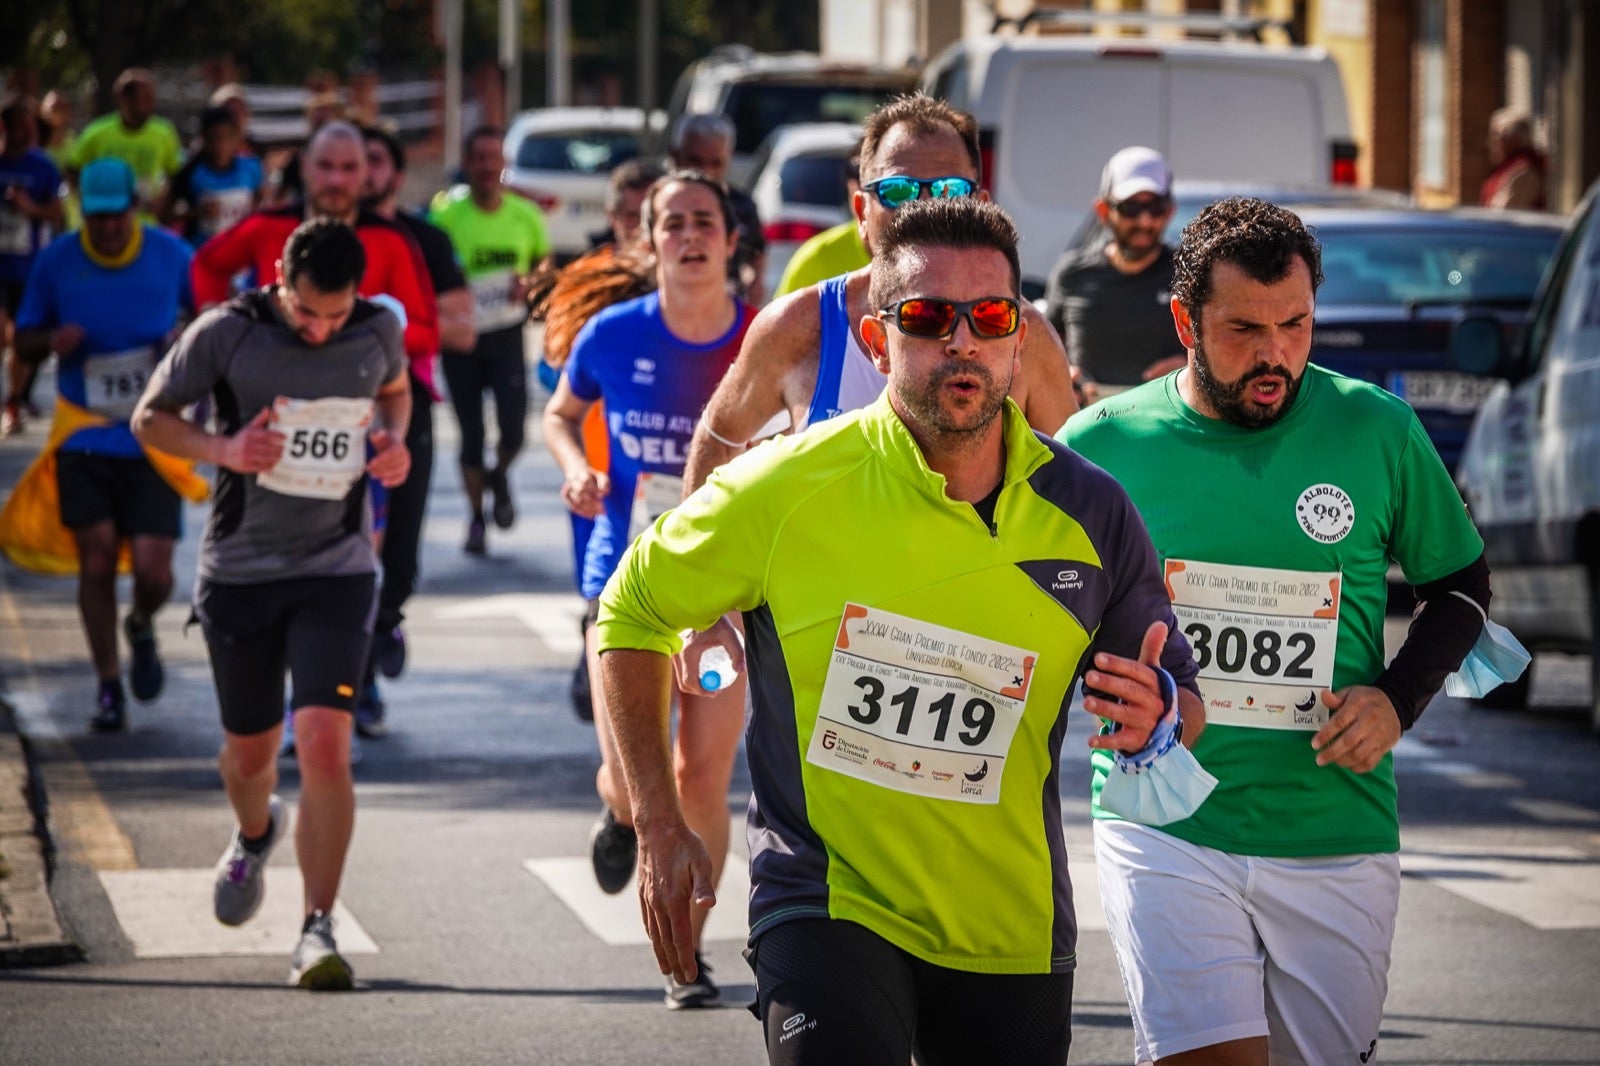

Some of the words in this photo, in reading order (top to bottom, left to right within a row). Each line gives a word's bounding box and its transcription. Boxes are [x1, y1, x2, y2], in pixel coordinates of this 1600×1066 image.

[625, 410, 666, 432] CLUB
[290, 428, 350, 462] 566
[1303, 487, 1351, 510] ALBOLOTE
[1301, 515, 1315, 536] PEÑA
[1315, 525, 1350, 542] DEPORTIVA
[1051, 580, 1084, 590] Kalenji
[1186, 572, 1206, 586] XXXV
[1299, 583, 1320, 597] 2022
[988, 653, 1013, 672] 2022
[1184, 622, 1316, 679] 3082
[847, 676, 996, 747] 3119
[960, 778, 983, 796] Lorca
[779, 1019, 817, 1044] Kalenji
